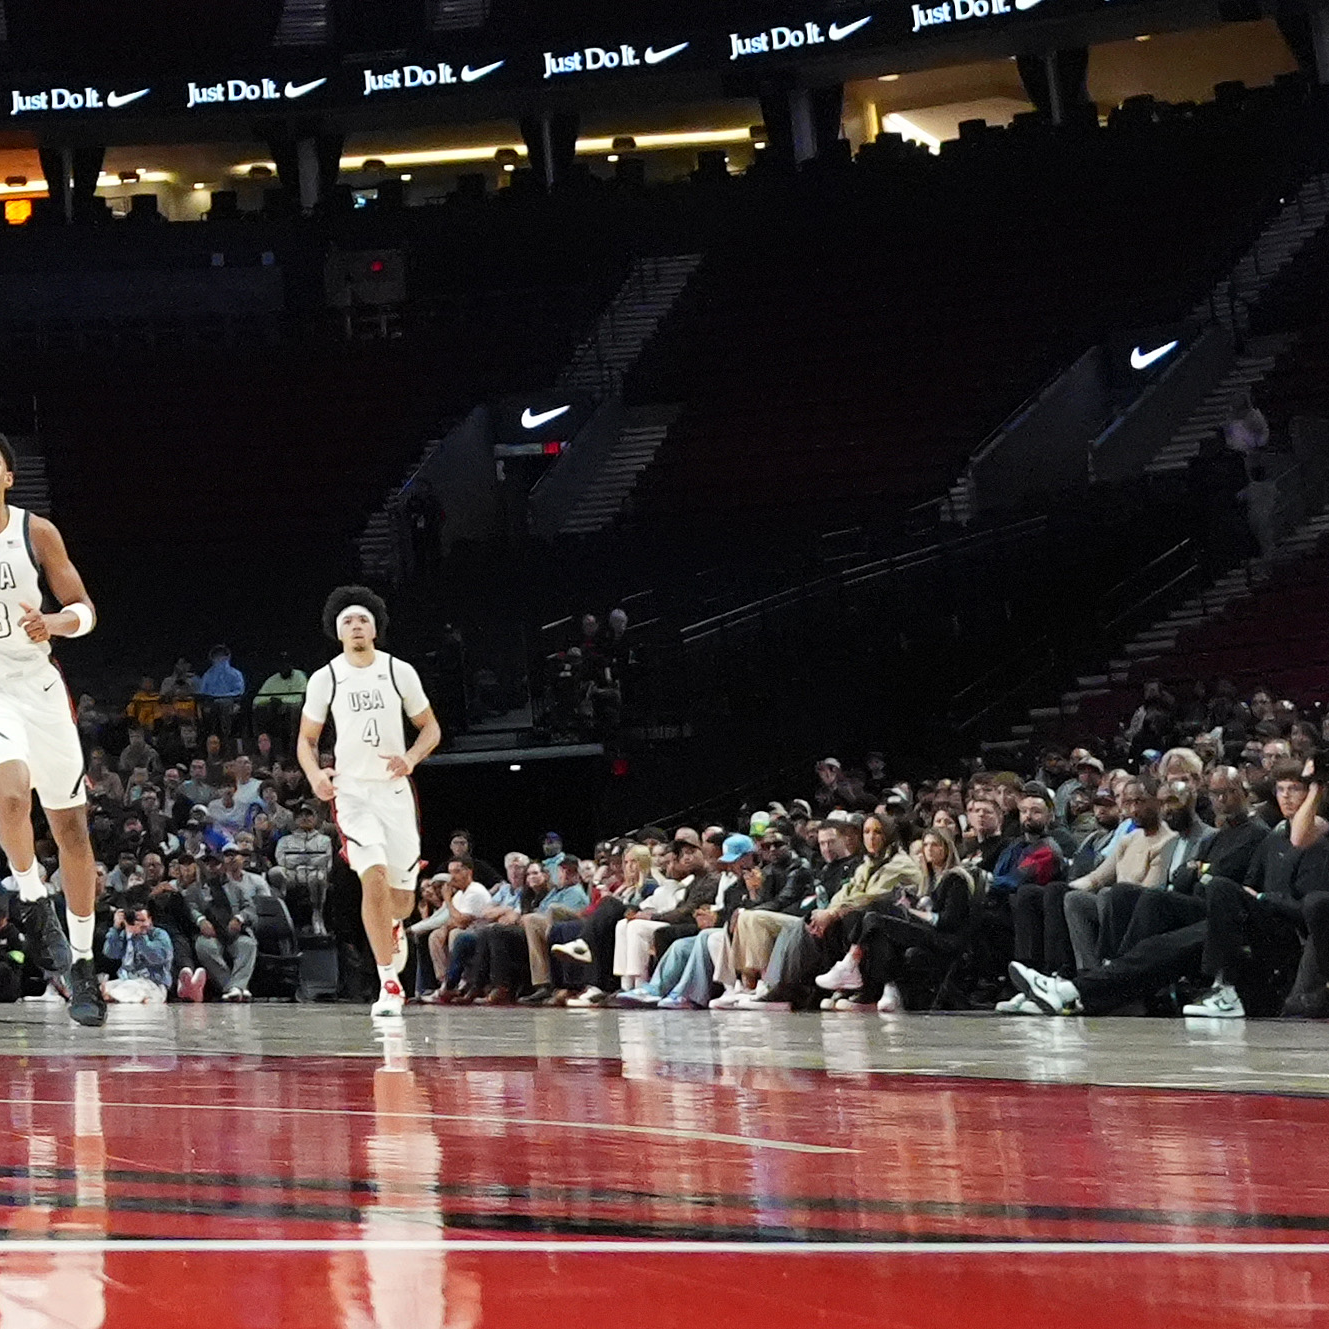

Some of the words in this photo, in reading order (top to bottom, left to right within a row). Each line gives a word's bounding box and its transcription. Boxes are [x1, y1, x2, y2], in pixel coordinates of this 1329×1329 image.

[911, 2, 952, 32] Just
[729, 32, 769, 60] Just
[770, 26, 805, 50] Do
[804, 22, 825, 45] It.
[543, 51, 583, 79] Just
[584, 47, 620, 70] Do
[619, 44, 641, 67] It.
[186, 82, 225, 108] Just
[226, 79, 261, 101] Do
[261, 78, 281, 99] It.
[363, 69, 401, 96] Just
[402, 65, 437, 88] Do
[437, 62, 457, 84] It.
[10, 90, 49, 115] Just
[50, 88, 84, 110] Do
[84, 87, 104, 108] It.
[347, 690, 384, 712] USA
[361, 718, 380, 747] 4
